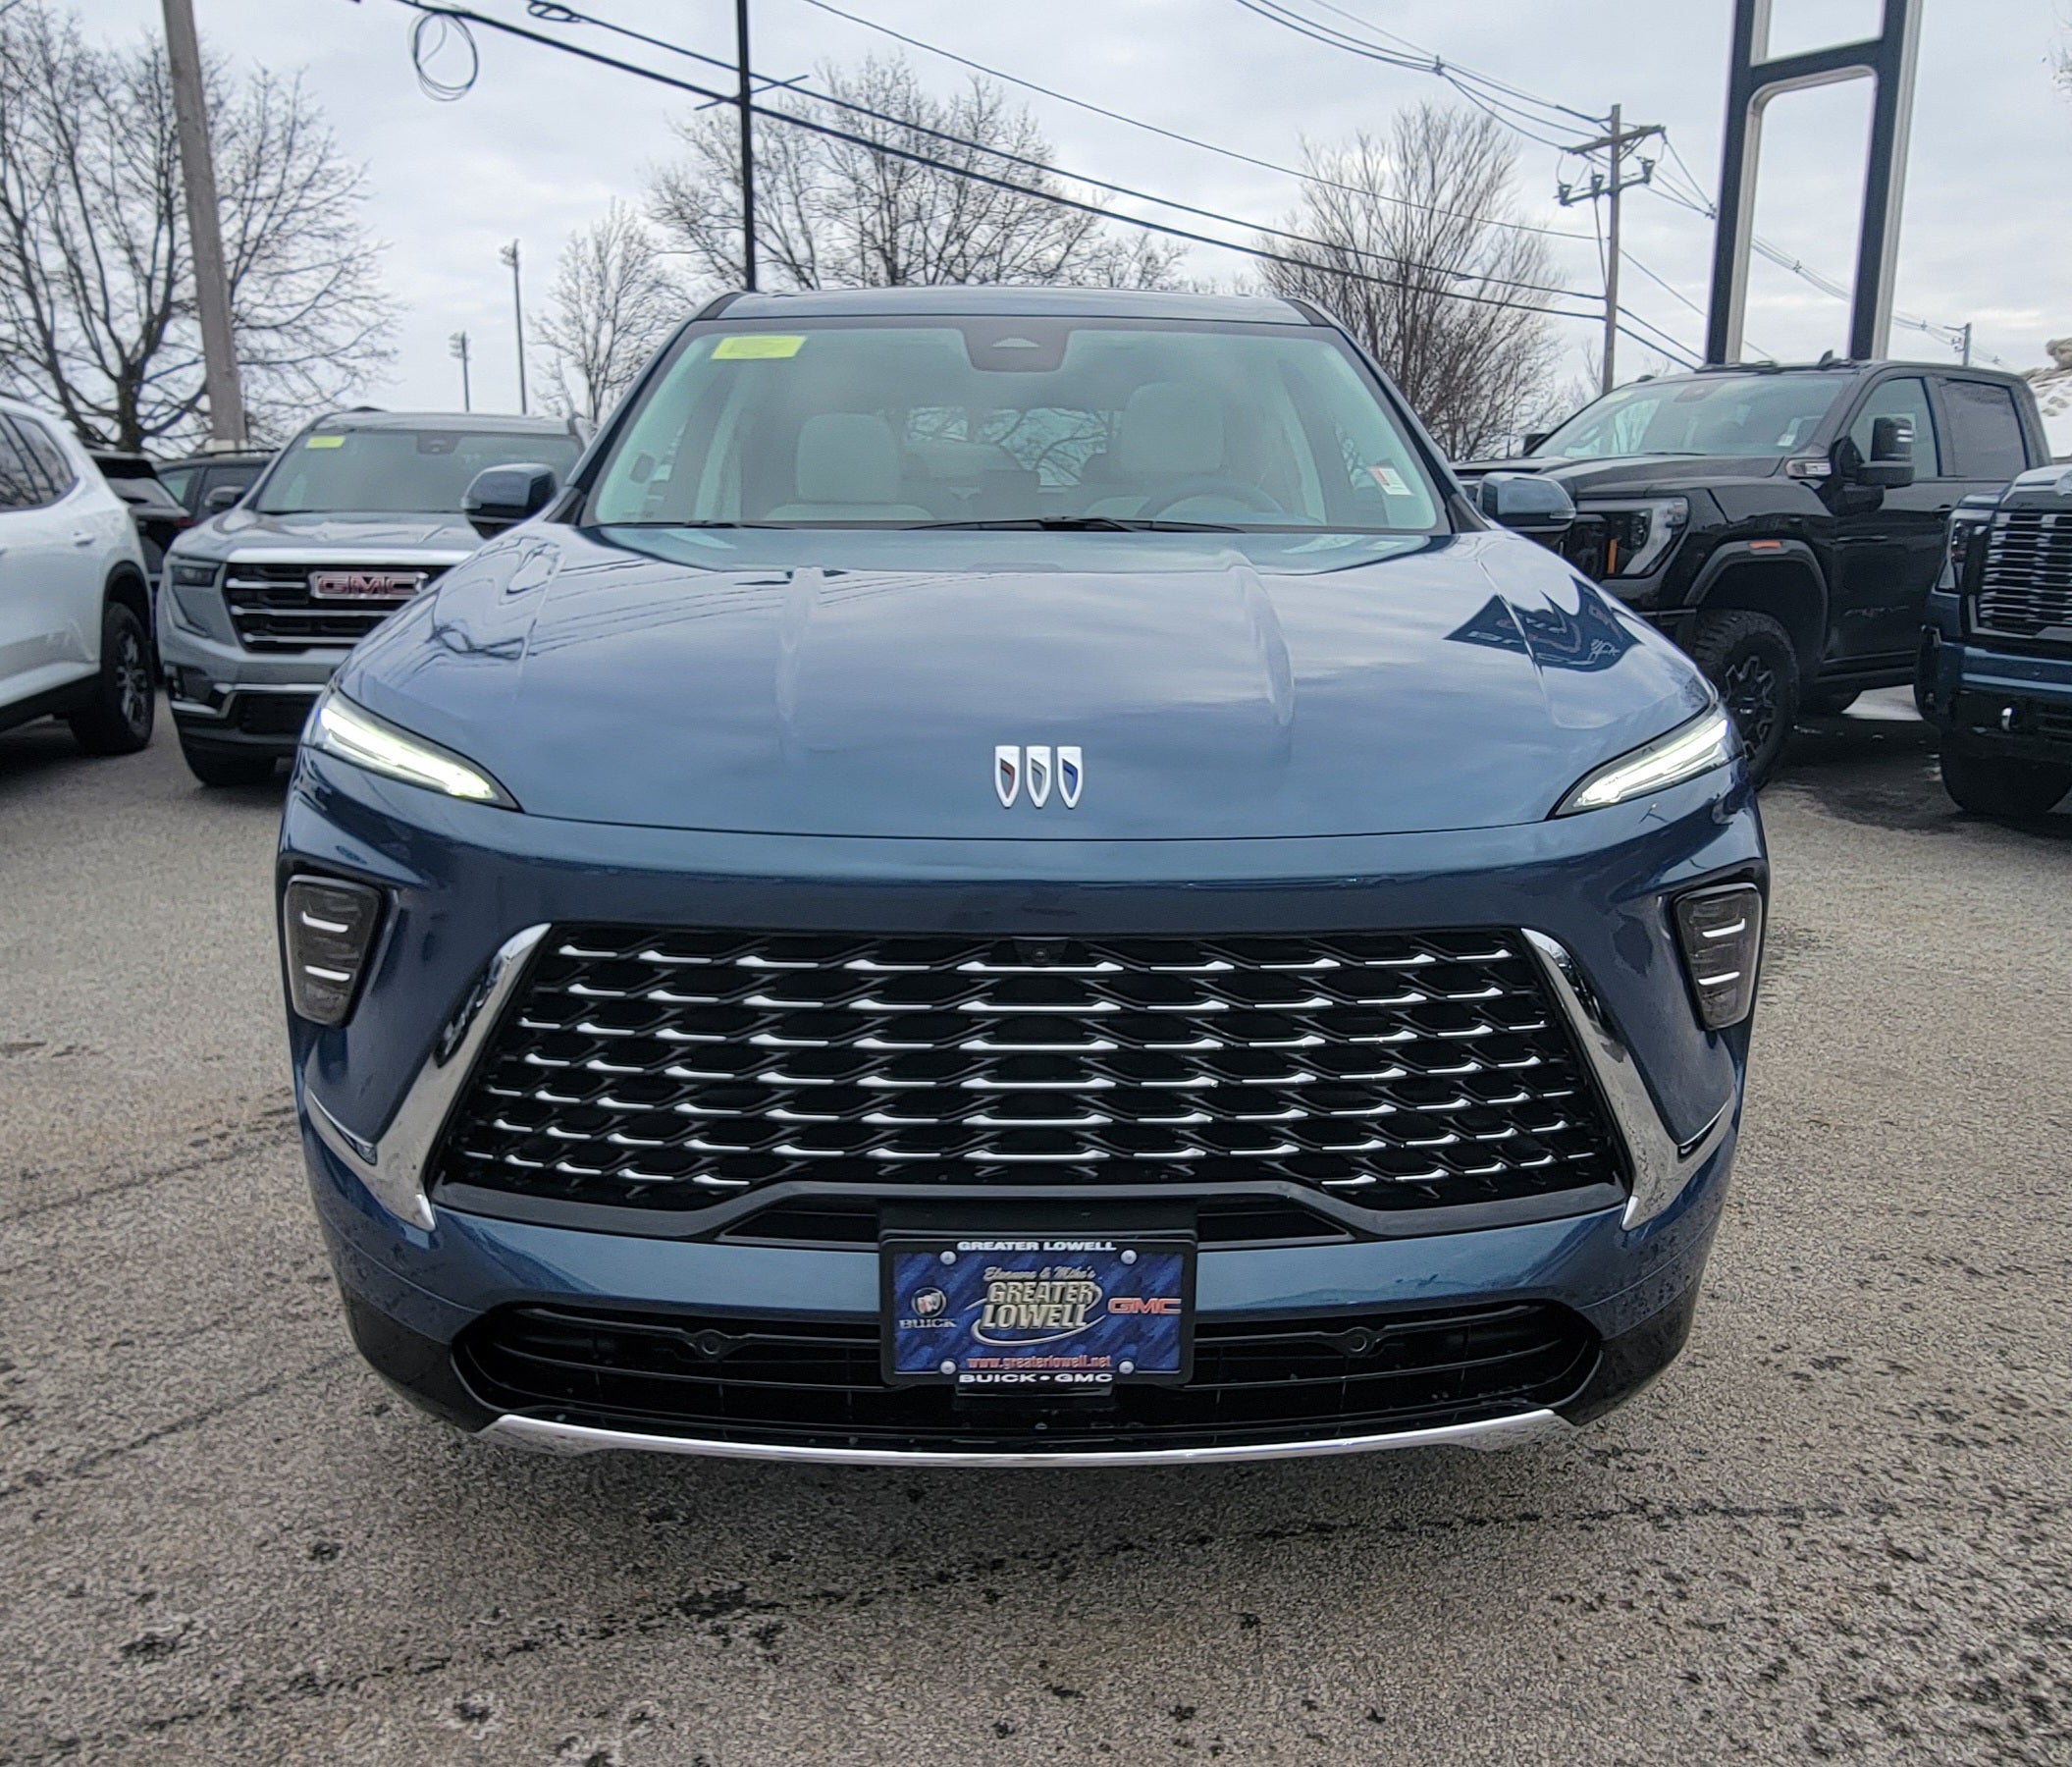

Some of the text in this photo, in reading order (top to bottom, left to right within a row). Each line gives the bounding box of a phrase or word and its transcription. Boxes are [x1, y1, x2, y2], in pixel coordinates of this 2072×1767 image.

[318, 575, 418, 595] GMC
[957, 1241, 1117, 1252] GREATER LOWELL
[986, 1281, 1094, 1305] GREATER
[1108, 1298, 1182, 1314] GMC
[899, 1318, 957, 1329] BUICK
[981, 1304, 1088, 1330] LOWELL
[967, 1355, 1111, 1369] www.greaterlowell.net
[959, 1373, 1113, 1383] BUICK GMC
